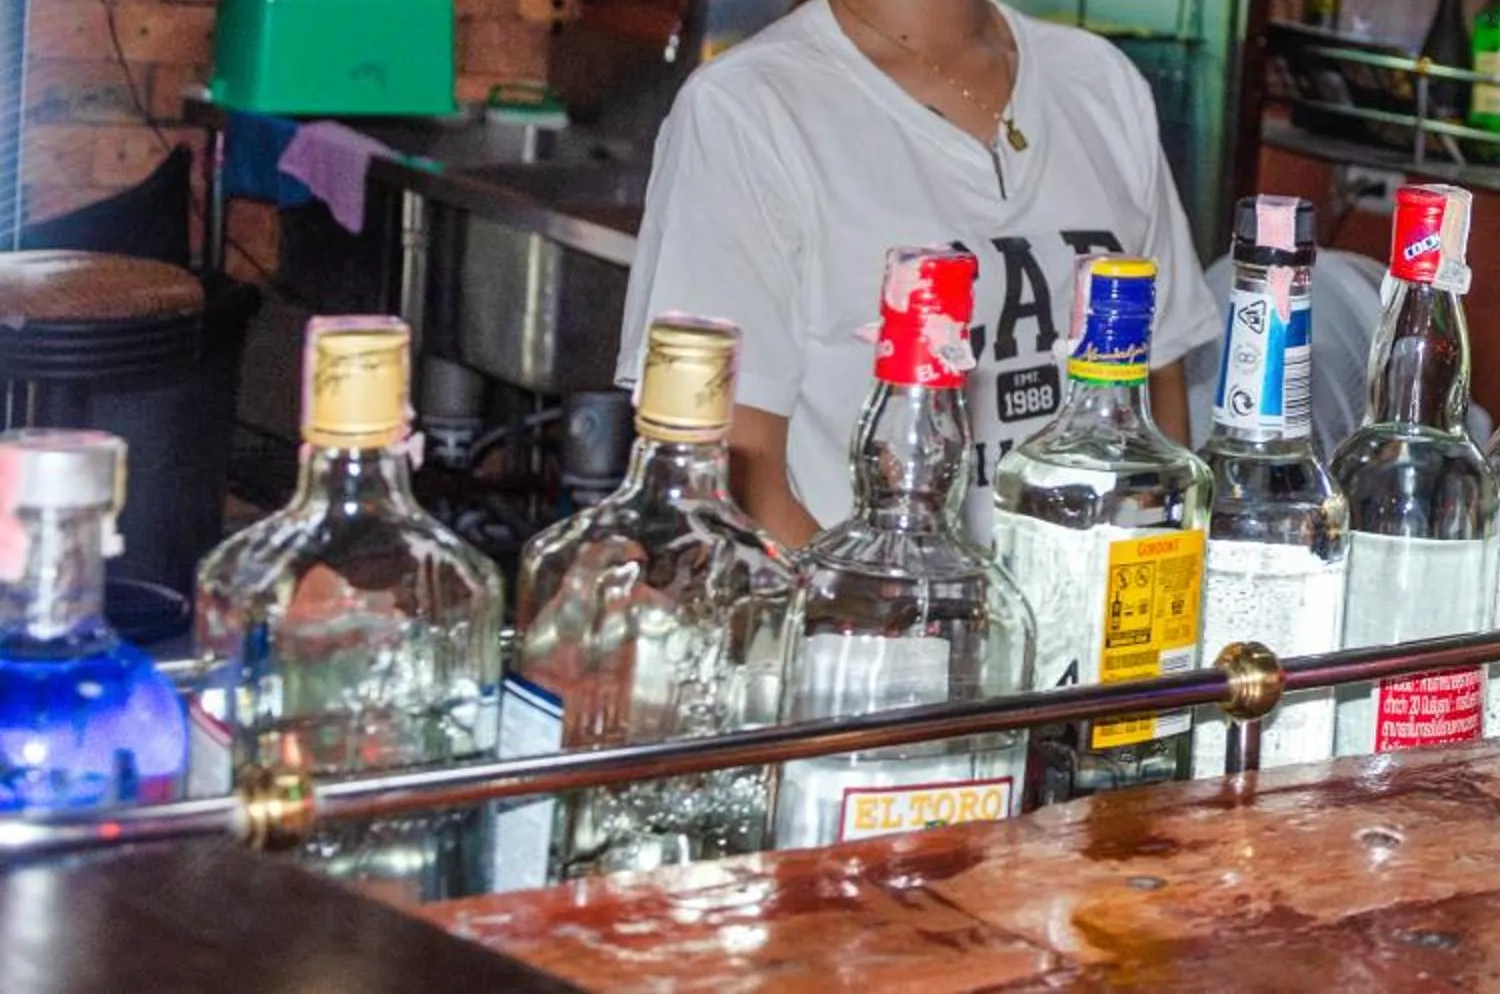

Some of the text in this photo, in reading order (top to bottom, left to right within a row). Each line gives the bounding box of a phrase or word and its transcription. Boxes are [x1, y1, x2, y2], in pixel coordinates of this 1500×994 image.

[1004, 384, 1055, 419] 1988
[855, 789, 1003, 830] EL TORO
